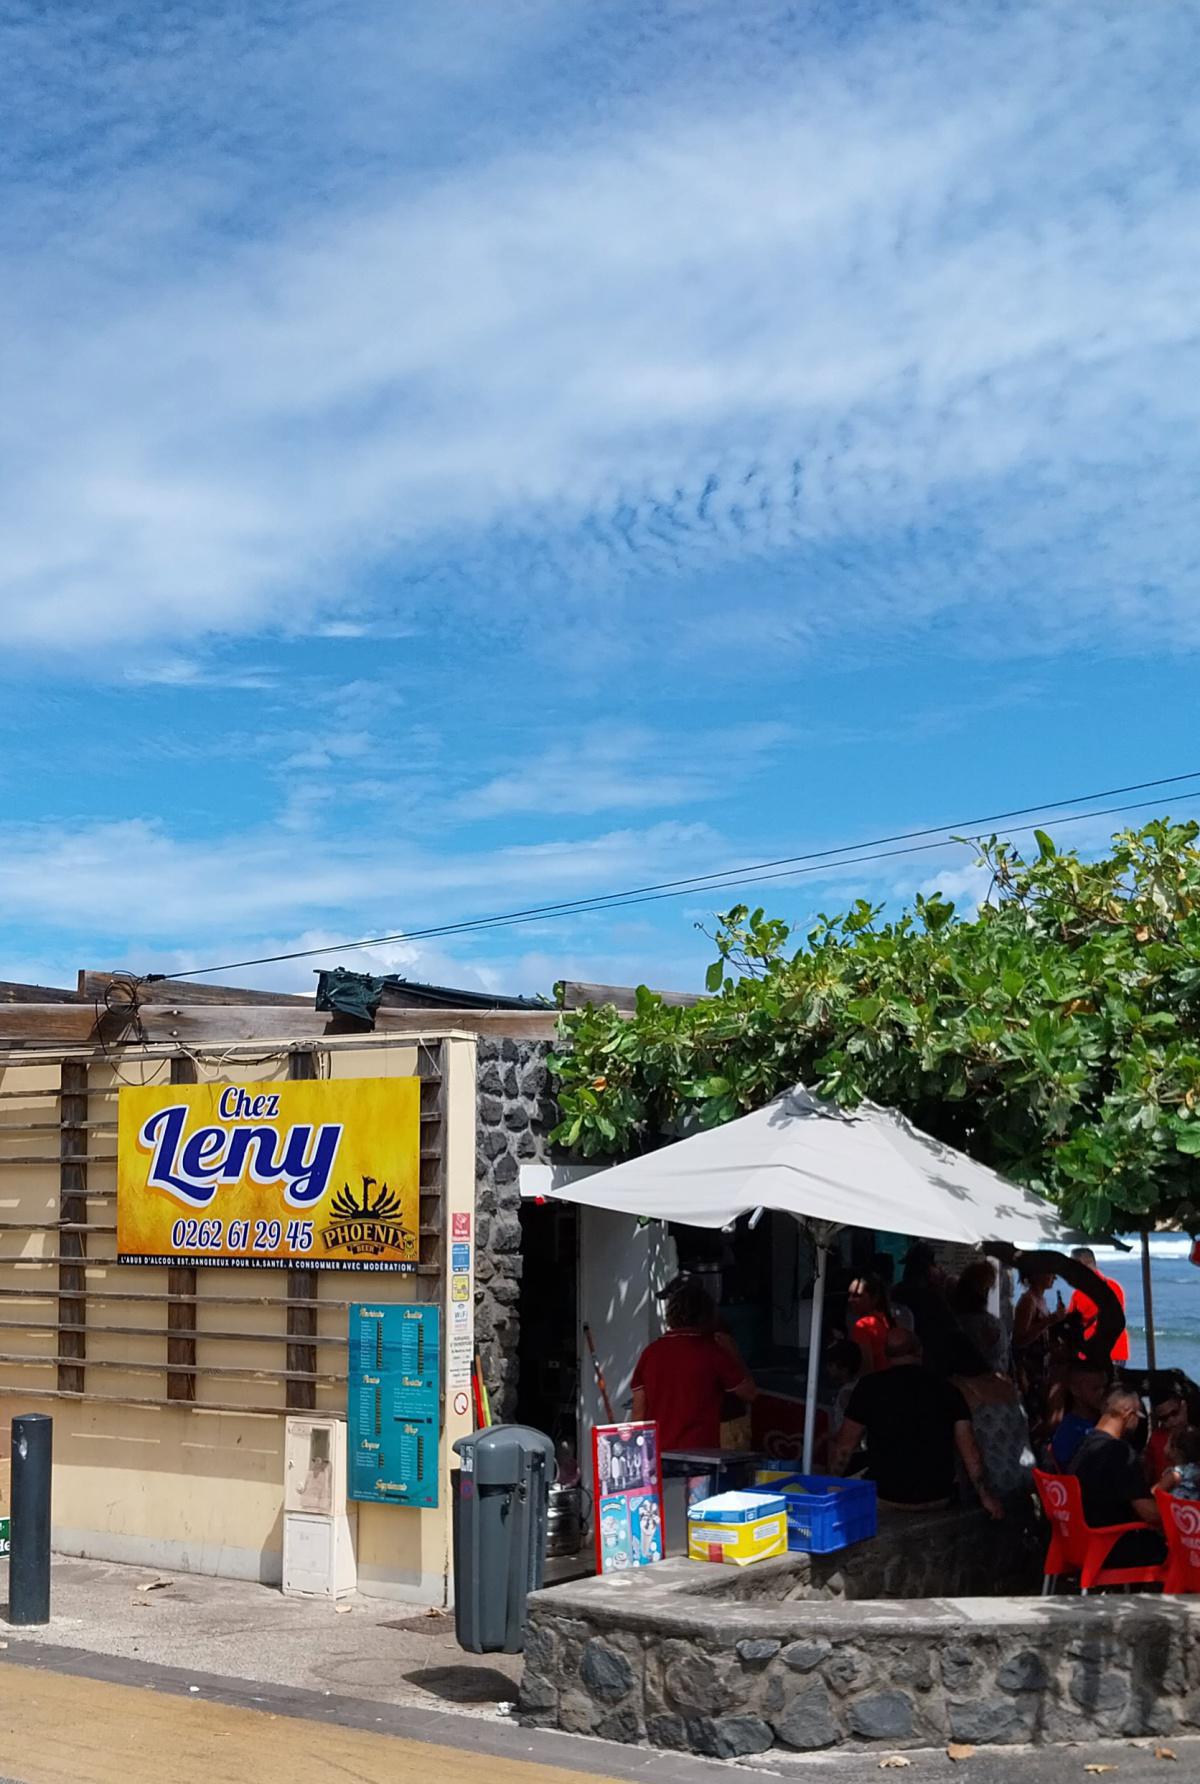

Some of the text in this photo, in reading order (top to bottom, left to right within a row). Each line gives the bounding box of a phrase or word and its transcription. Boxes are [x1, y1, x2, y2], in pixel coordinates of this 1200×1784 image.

[219, 1086, 280, 1119] Chez
[141, 1105, 343, 1205] Leny
[173, 1219, 312, 1250] 0262 61 29 45
[324, 1223, 405, 1250] PHOENIX
[121, 1256, 142, 1264] L'ABUS
[144, 1256, 175, 1265] D'ALCOOL
[191, 1257, 229, 1266] DANGEREUX
[231, 1258, 249, 1267] POUR
[295, 1260, 340, 1270] CONSOMMER
[342, 1262, 360, 1270] AVEC
